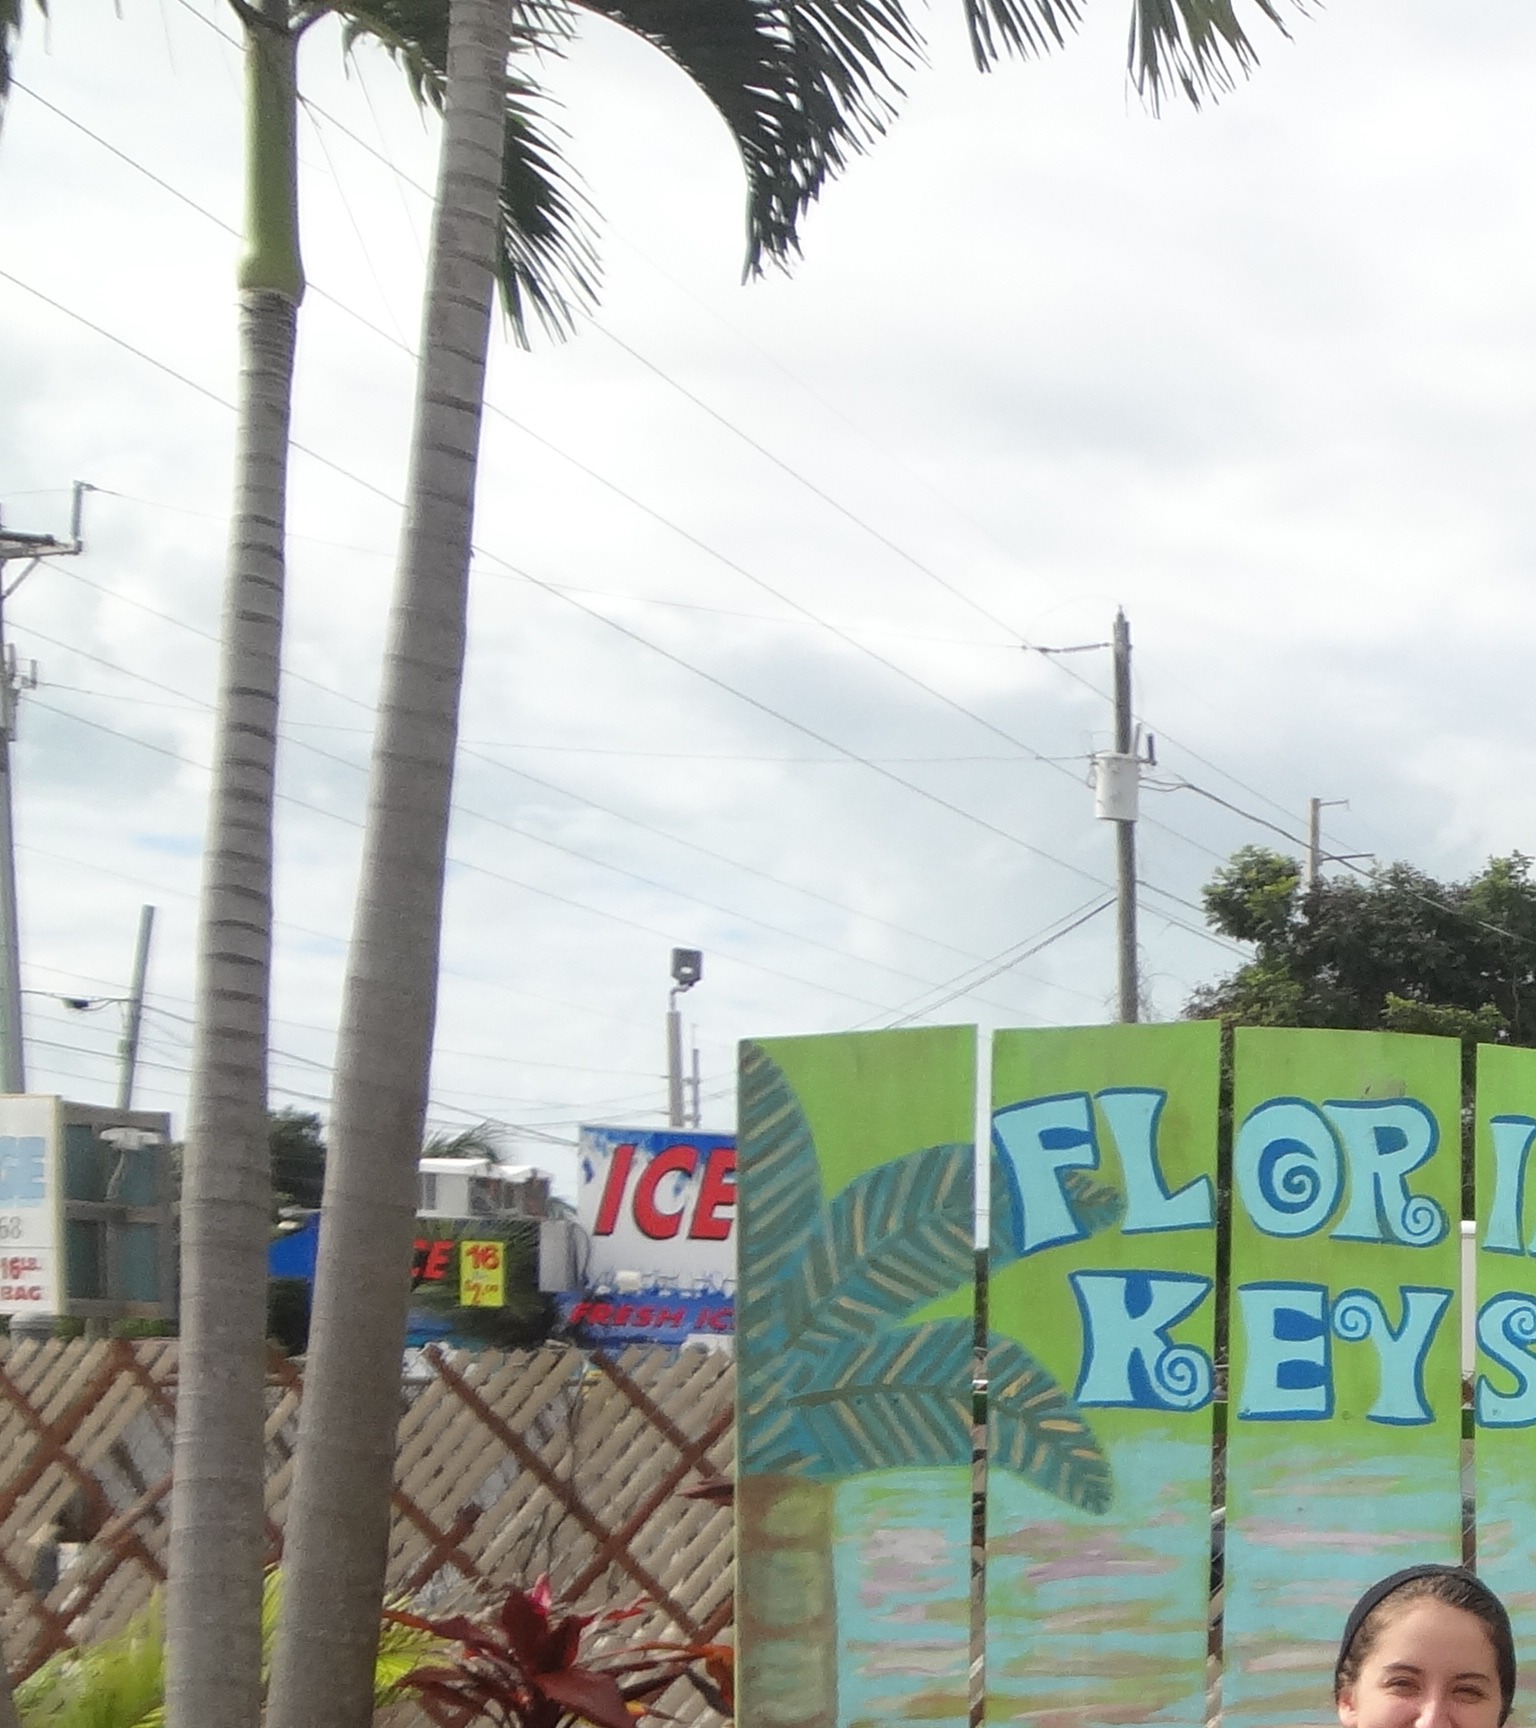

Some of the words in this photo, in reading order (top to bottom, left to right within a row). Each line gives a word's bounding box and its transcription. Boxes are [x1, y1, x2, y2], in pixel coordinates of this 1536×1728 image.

[593, 1143, 738, 1240] ICE
[0, 1286, 42, 1301] BAG
[568, 1301, 686, 1328] FRESH
[695, 1306, 736, 1331] IC
